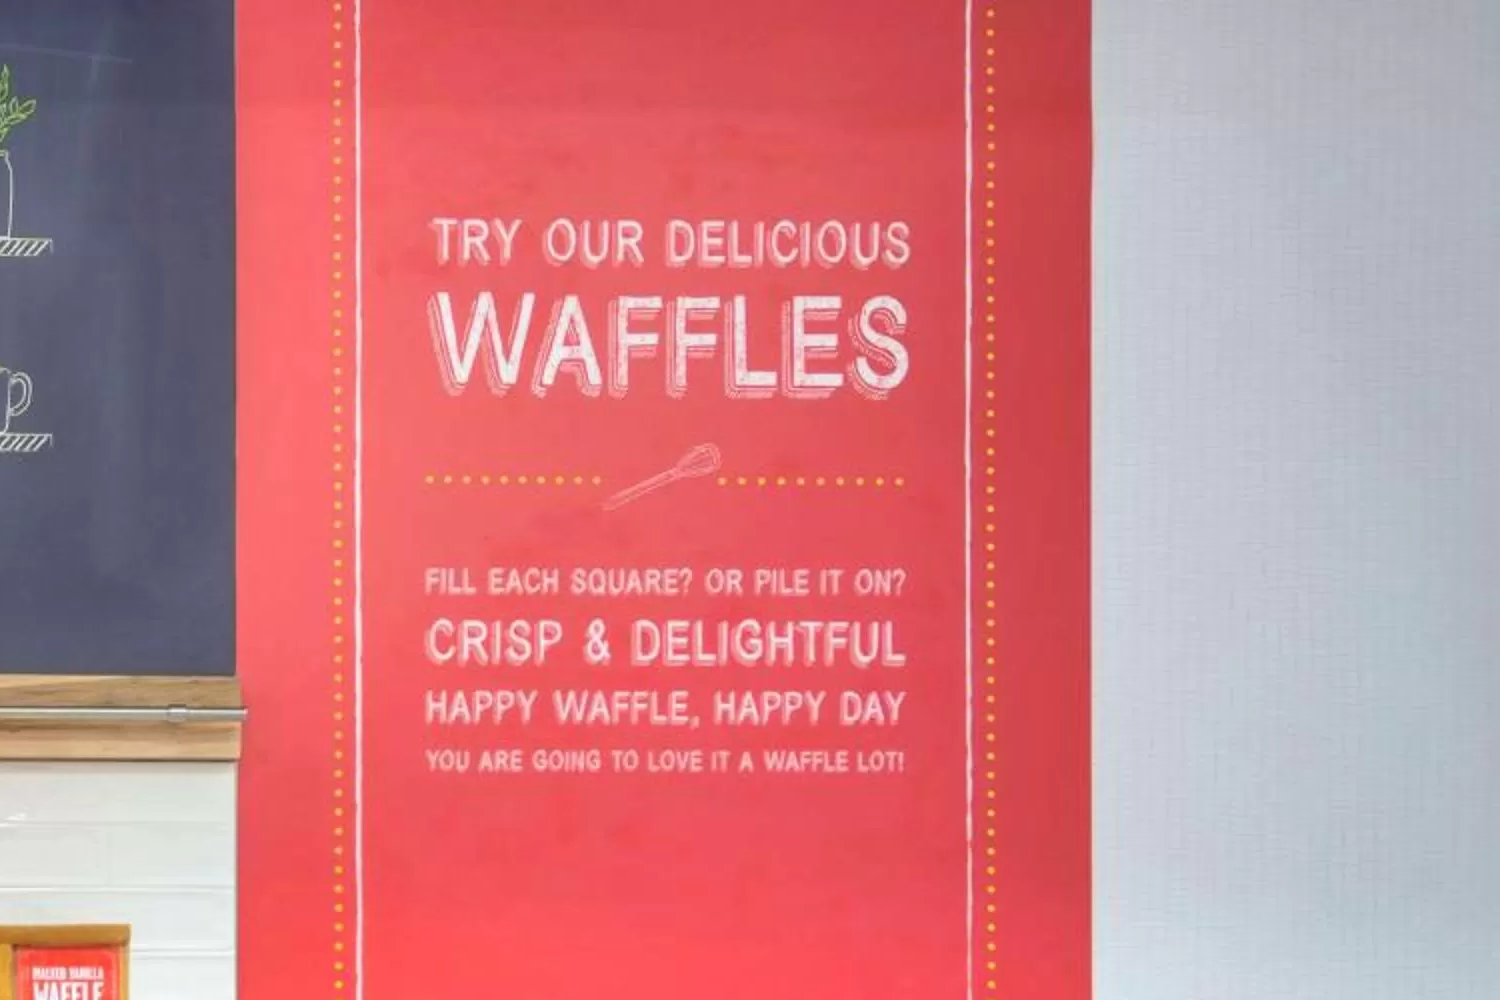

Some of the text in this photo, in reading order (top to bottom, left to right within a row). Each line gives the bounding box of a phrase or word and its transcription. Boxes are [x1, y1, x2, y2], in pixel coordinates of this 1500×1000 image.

[433, 218, 911, 270] TRY OUR DELICIOUS
[426, 291, 910, 400] WAFFLES
[425, 567, 907, 597] FILL EACH SQUARE? OR PILE IT ON?
[424, 618, 907, 669] CRISP & DELIGHTFUL
[425, 689, 907, 729] HAPPY WAFFLE, HAPPY DAY
[426, 748, 905, 775] YOU ARE GOING TO LOVE IT A WAFFLE LOT!
